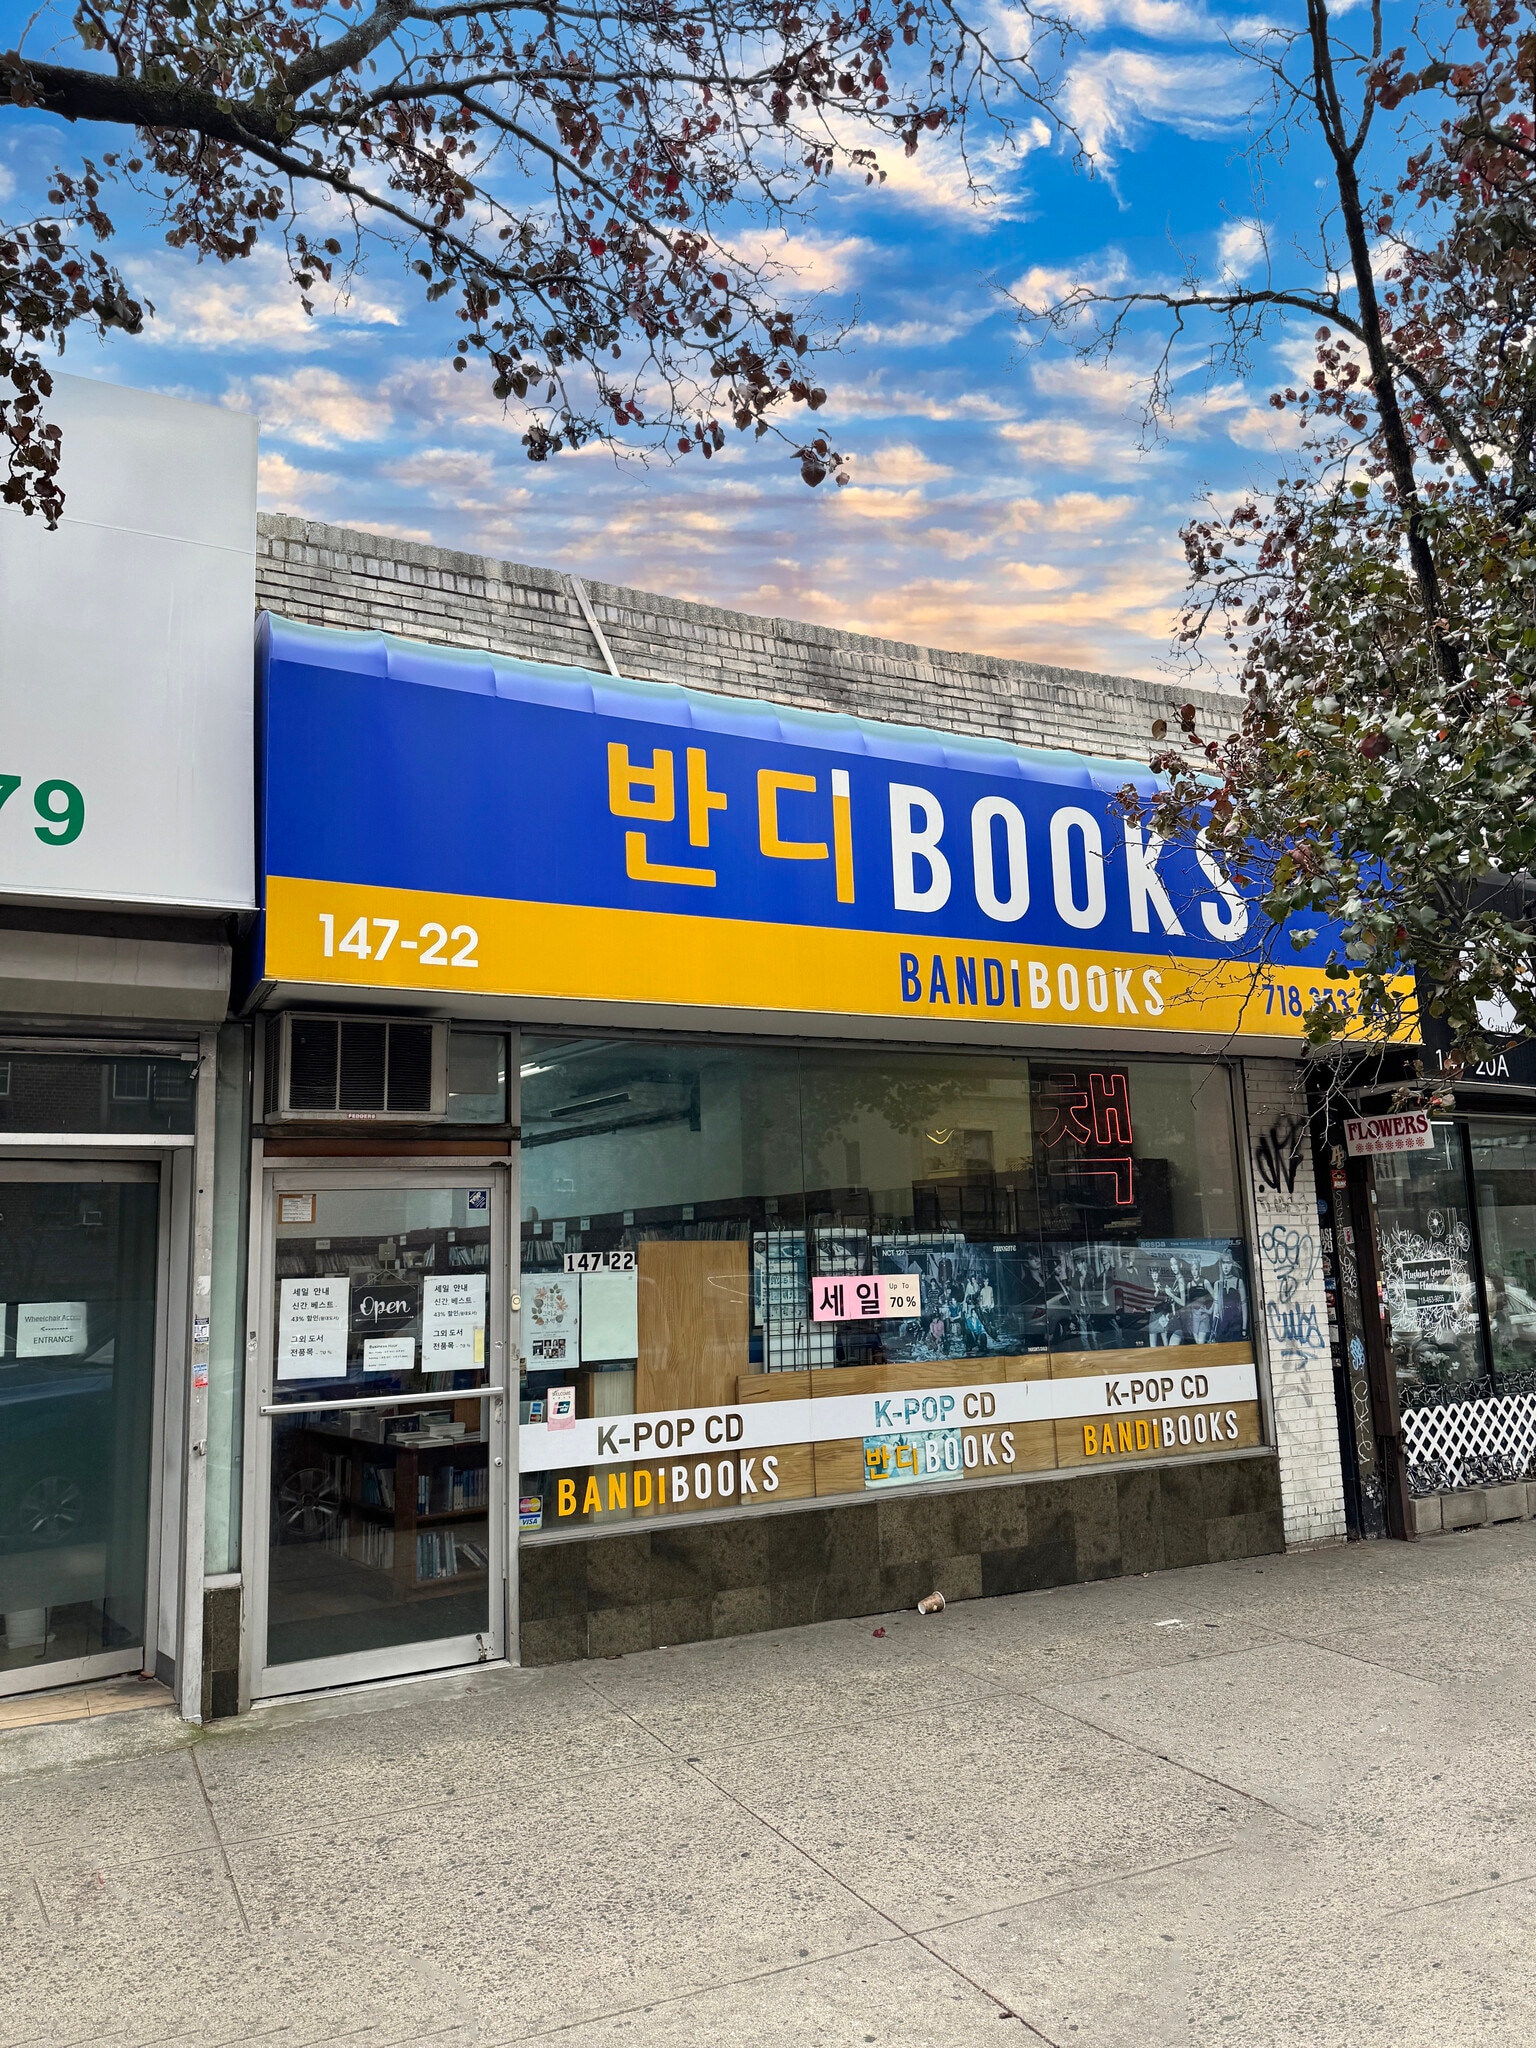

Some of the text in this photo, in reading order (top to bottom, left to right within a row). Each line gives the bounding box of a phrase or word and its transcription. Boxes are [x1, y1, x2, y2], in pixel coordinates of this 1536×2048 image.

[607, 741, 1249, 942] 반디 BOOKS
[319, 913, 479, 968] 147-22
[1436, 1049, 1510, 1078] 1-20A
[1040, 1073, 1133, 1205] 책
[1347, 1114, 1428, 1141] FLOWERS
[882, 1249, 895, 1257] NCT
[1140, 1241, 1166, 1249] aespa
[567, 1252, 634, 1272] 147 22
[1404, 1266, 1451, 1280] Flushing Garden
[292, 1287, 330, 1297] 세일 안내
[434, 1284, 468, 1293] 세일 안내
[311, 1301, 334, 1309] 베스트
[360, 1296, 411, 1324] Open
[33, 1336, 74, 1344] ENTRANCE
[308, 1334, 324, 1342] 도서
[1105, 1375, 1209, 1407] K-POP CD
[874, 1392, 996, 1428] K-POP CD
[597, 1413, 744, 1456] K-POP CD
[866, 1430, 1016, 1480] 반디 BOOKS
